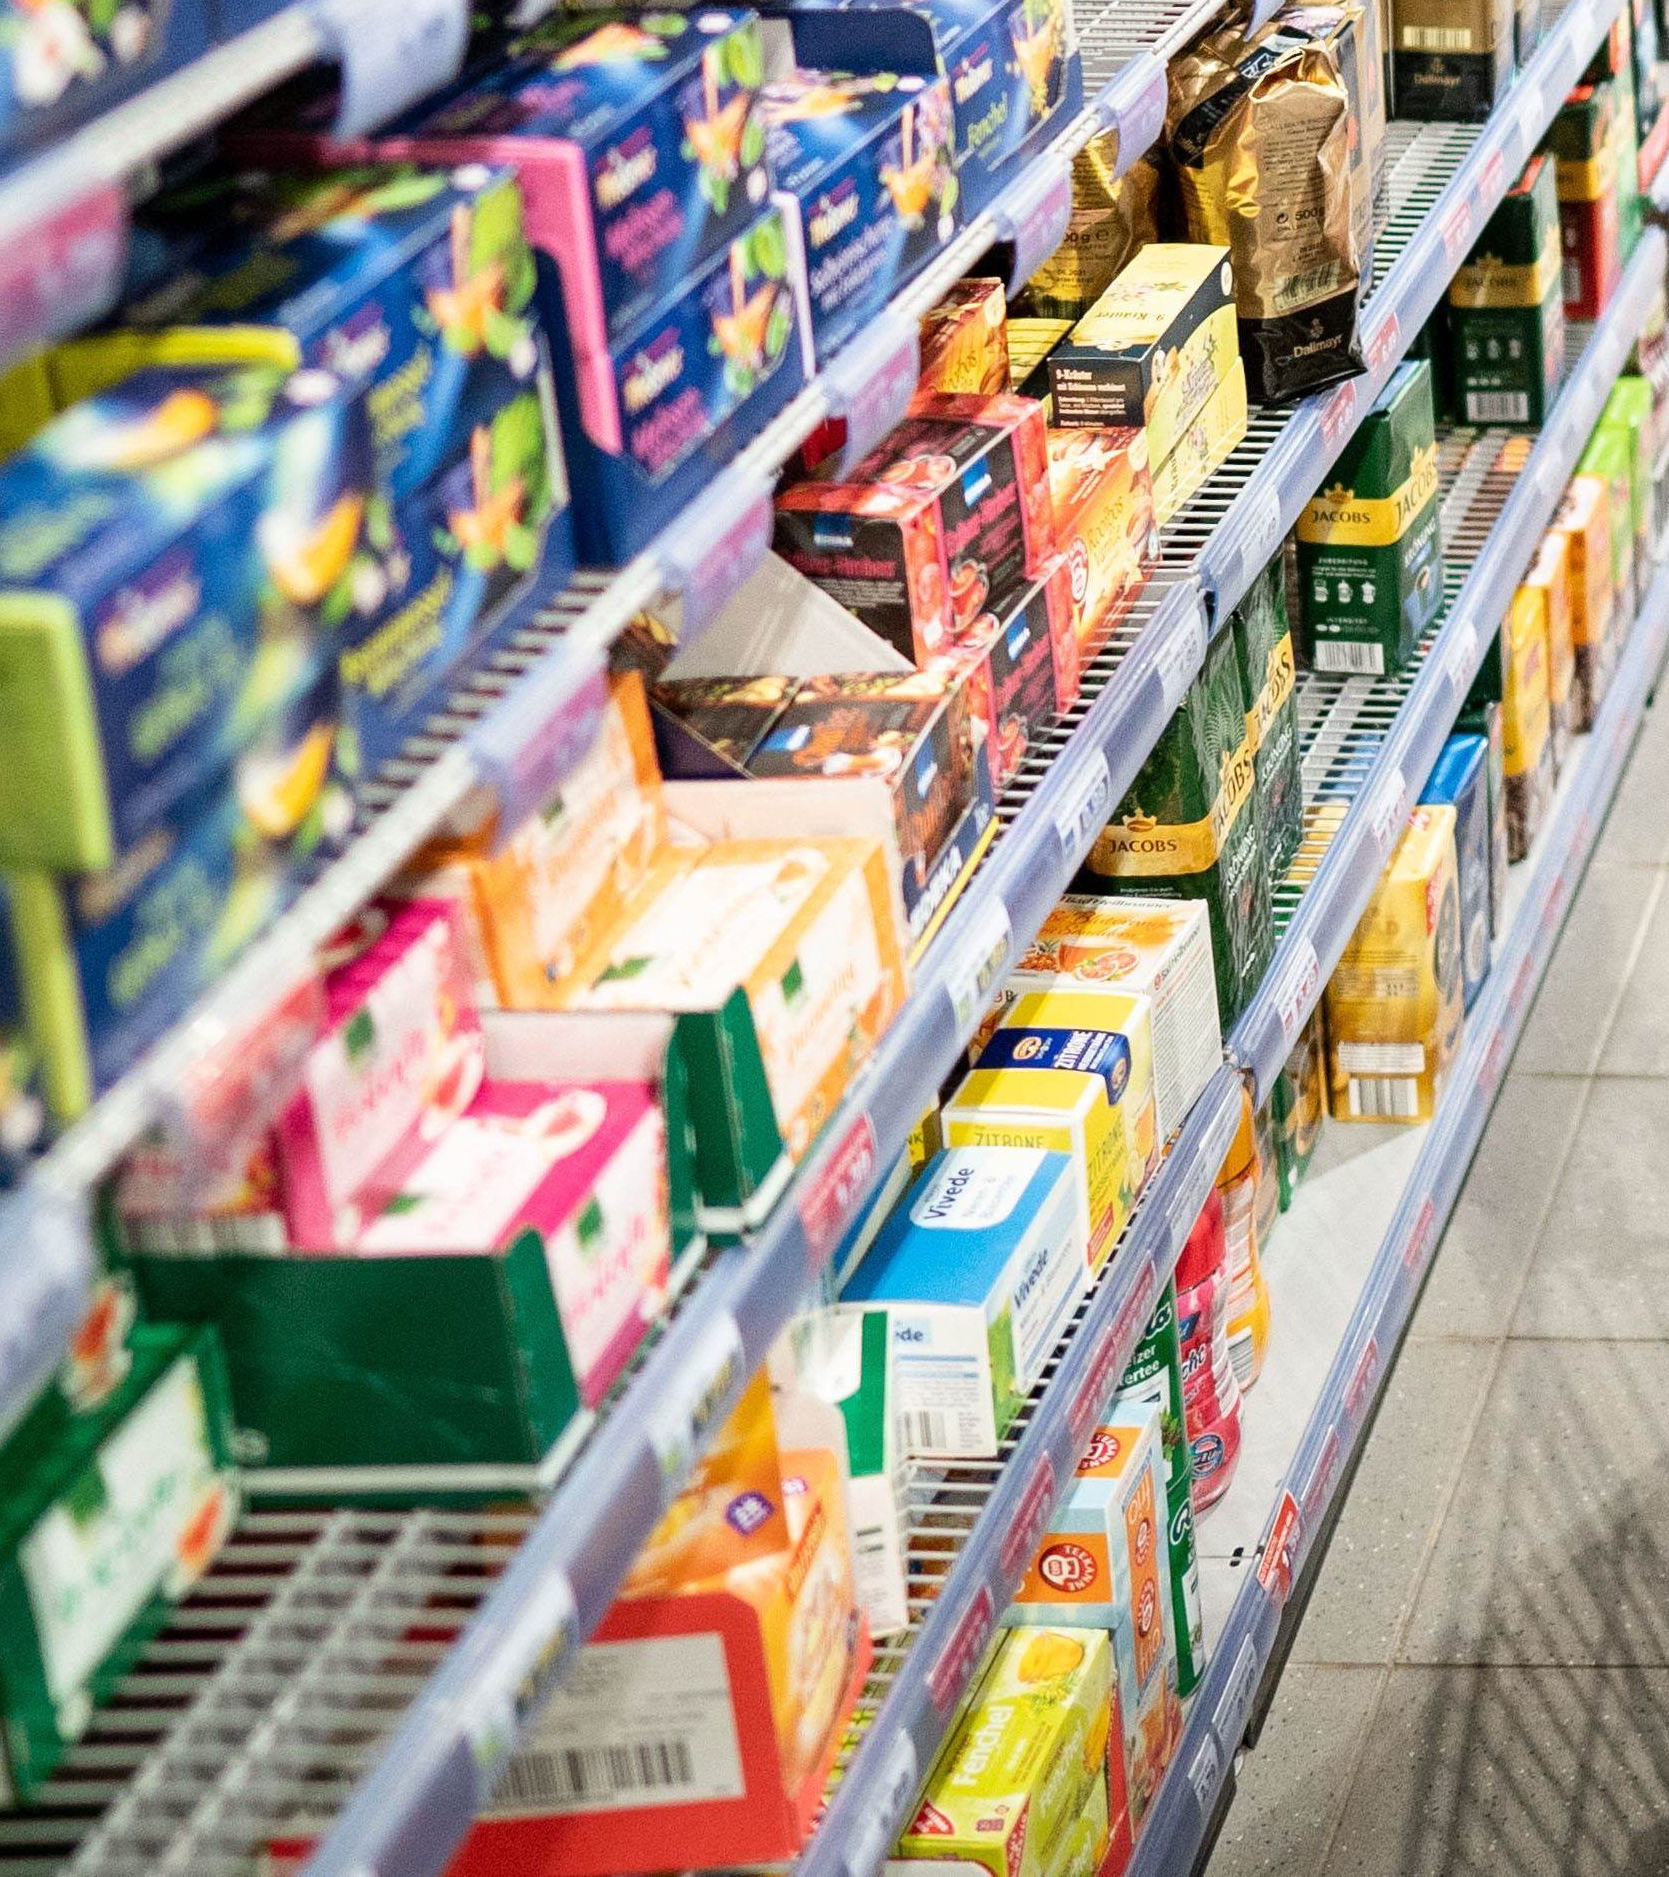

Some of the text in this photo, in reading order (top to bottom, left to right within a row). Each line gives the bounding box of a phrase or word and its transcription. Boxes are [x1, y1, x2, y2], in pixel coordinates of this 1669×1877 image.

[1292, 334, 1342, 360] Dallmayr
[1311, 510, 1371, 524] JACOBS
[1108, 837, 1178, 854] JACOBS
[1058, 1030, 1092, 1070] ZITRONE
[974, 1130, 1045, 1149] ZITRONE
[924, 1166, 975, 1222] Vivede
[1012, 1248, 1049, 1311] Vivede
[951, 1703, 1015, 1788] Fenchel
